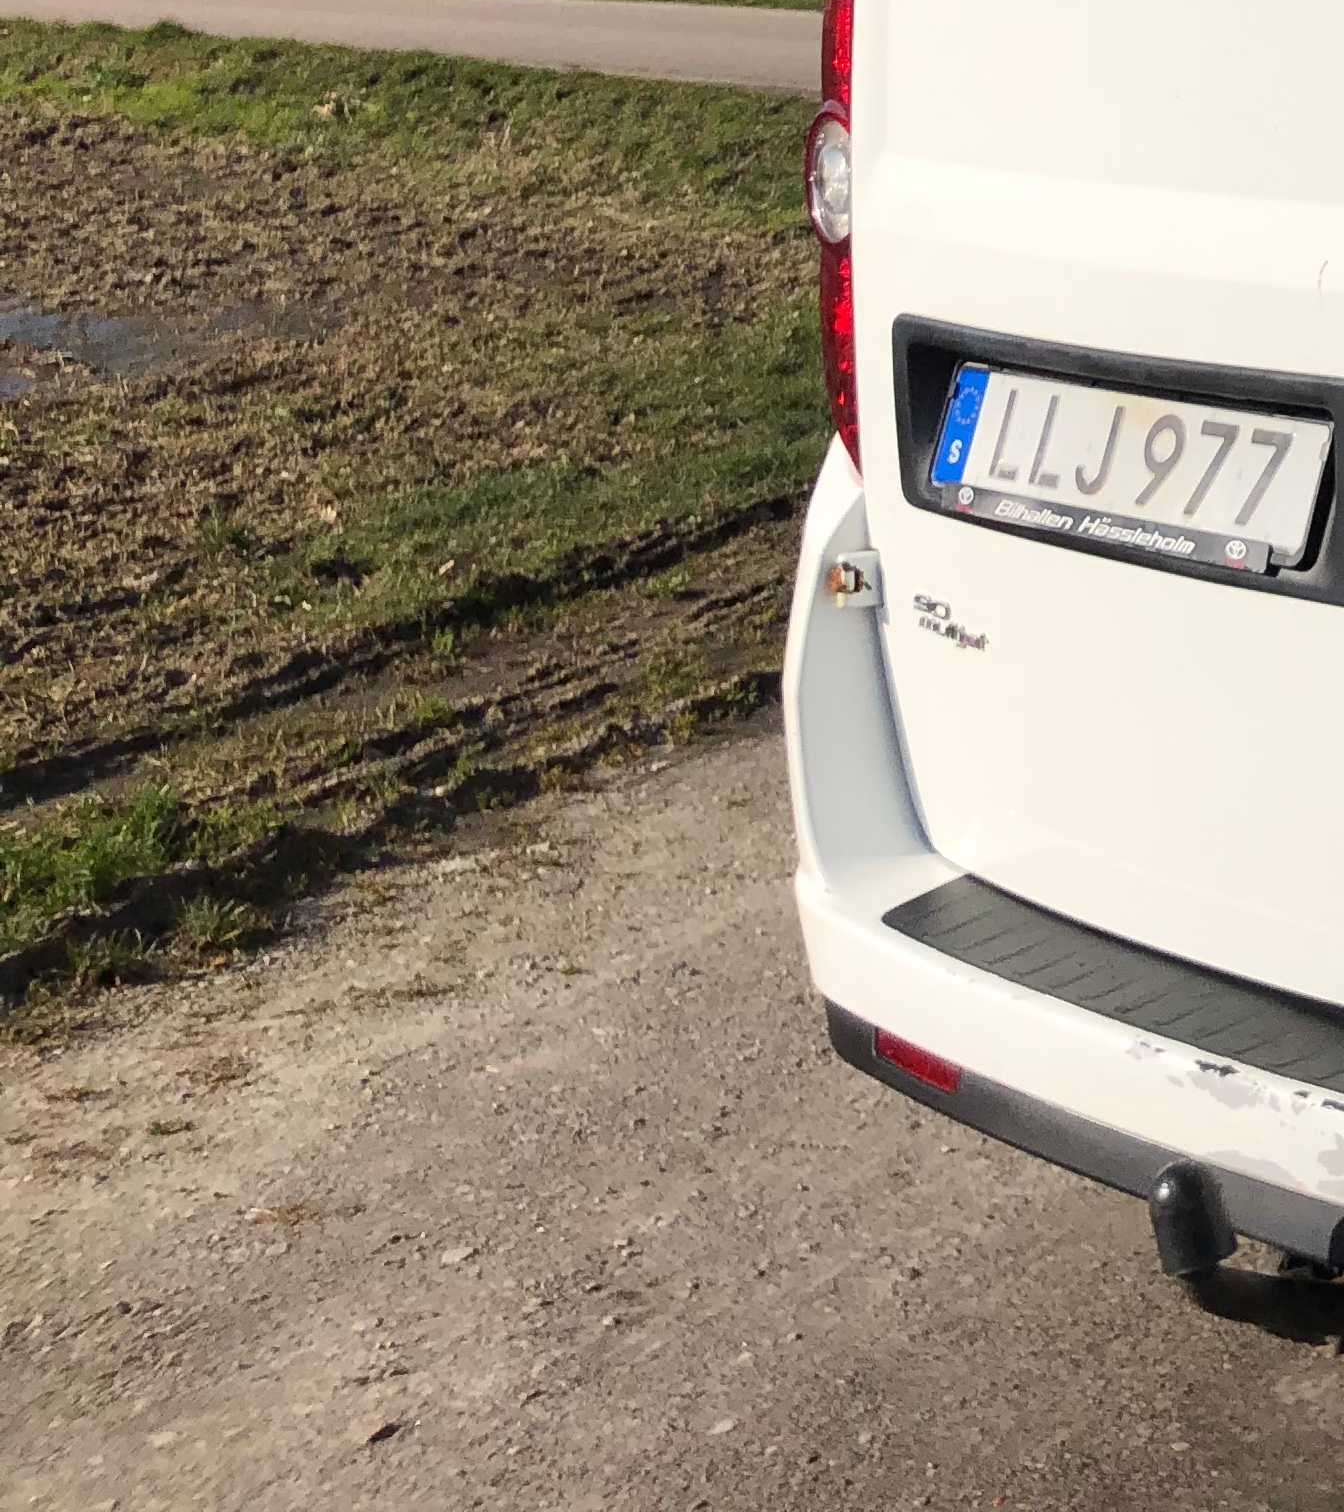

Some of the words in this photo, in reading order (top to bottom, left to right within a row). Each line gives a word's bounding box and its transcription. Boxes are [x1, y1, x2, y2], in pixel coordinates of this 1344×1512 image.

[947, 438, 963, 464] S
[994, 498, 1074, 531] Bilhallen
[1079, 515, 1196, 555] Hässleholm
